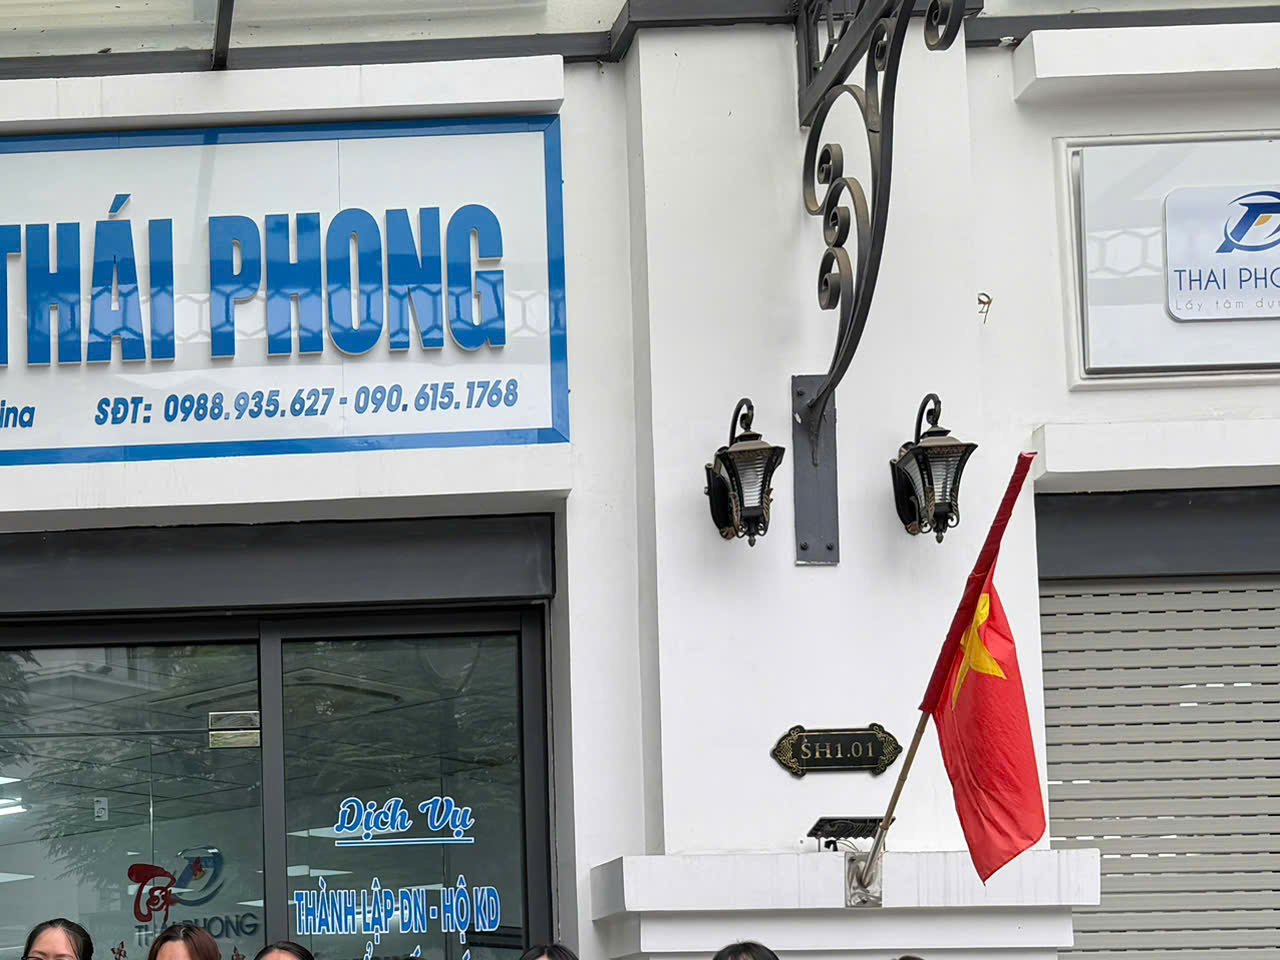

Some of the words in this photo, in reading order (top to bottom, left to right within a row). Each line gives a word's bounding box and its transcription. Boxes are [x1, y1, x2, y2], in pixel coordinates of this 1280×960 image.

[209, 203, 507, 361] PHONG
[1174, 267, 1226, 291] THAI
[94, 396, 152, 426] SĐT:
[163, 387, 335, 423] 0988.935.627
[800, 741, 876, 759] SH1.01
[334, 796, 413, 841] Dịch
[418, 796, 475, 839] Vụ
[294, 876, 357, 935] THÀNH
[361, 877, 395, 945] LẬP
[440, 874, 470, 944] HỘ
[472, 886, 501, 932] KD
